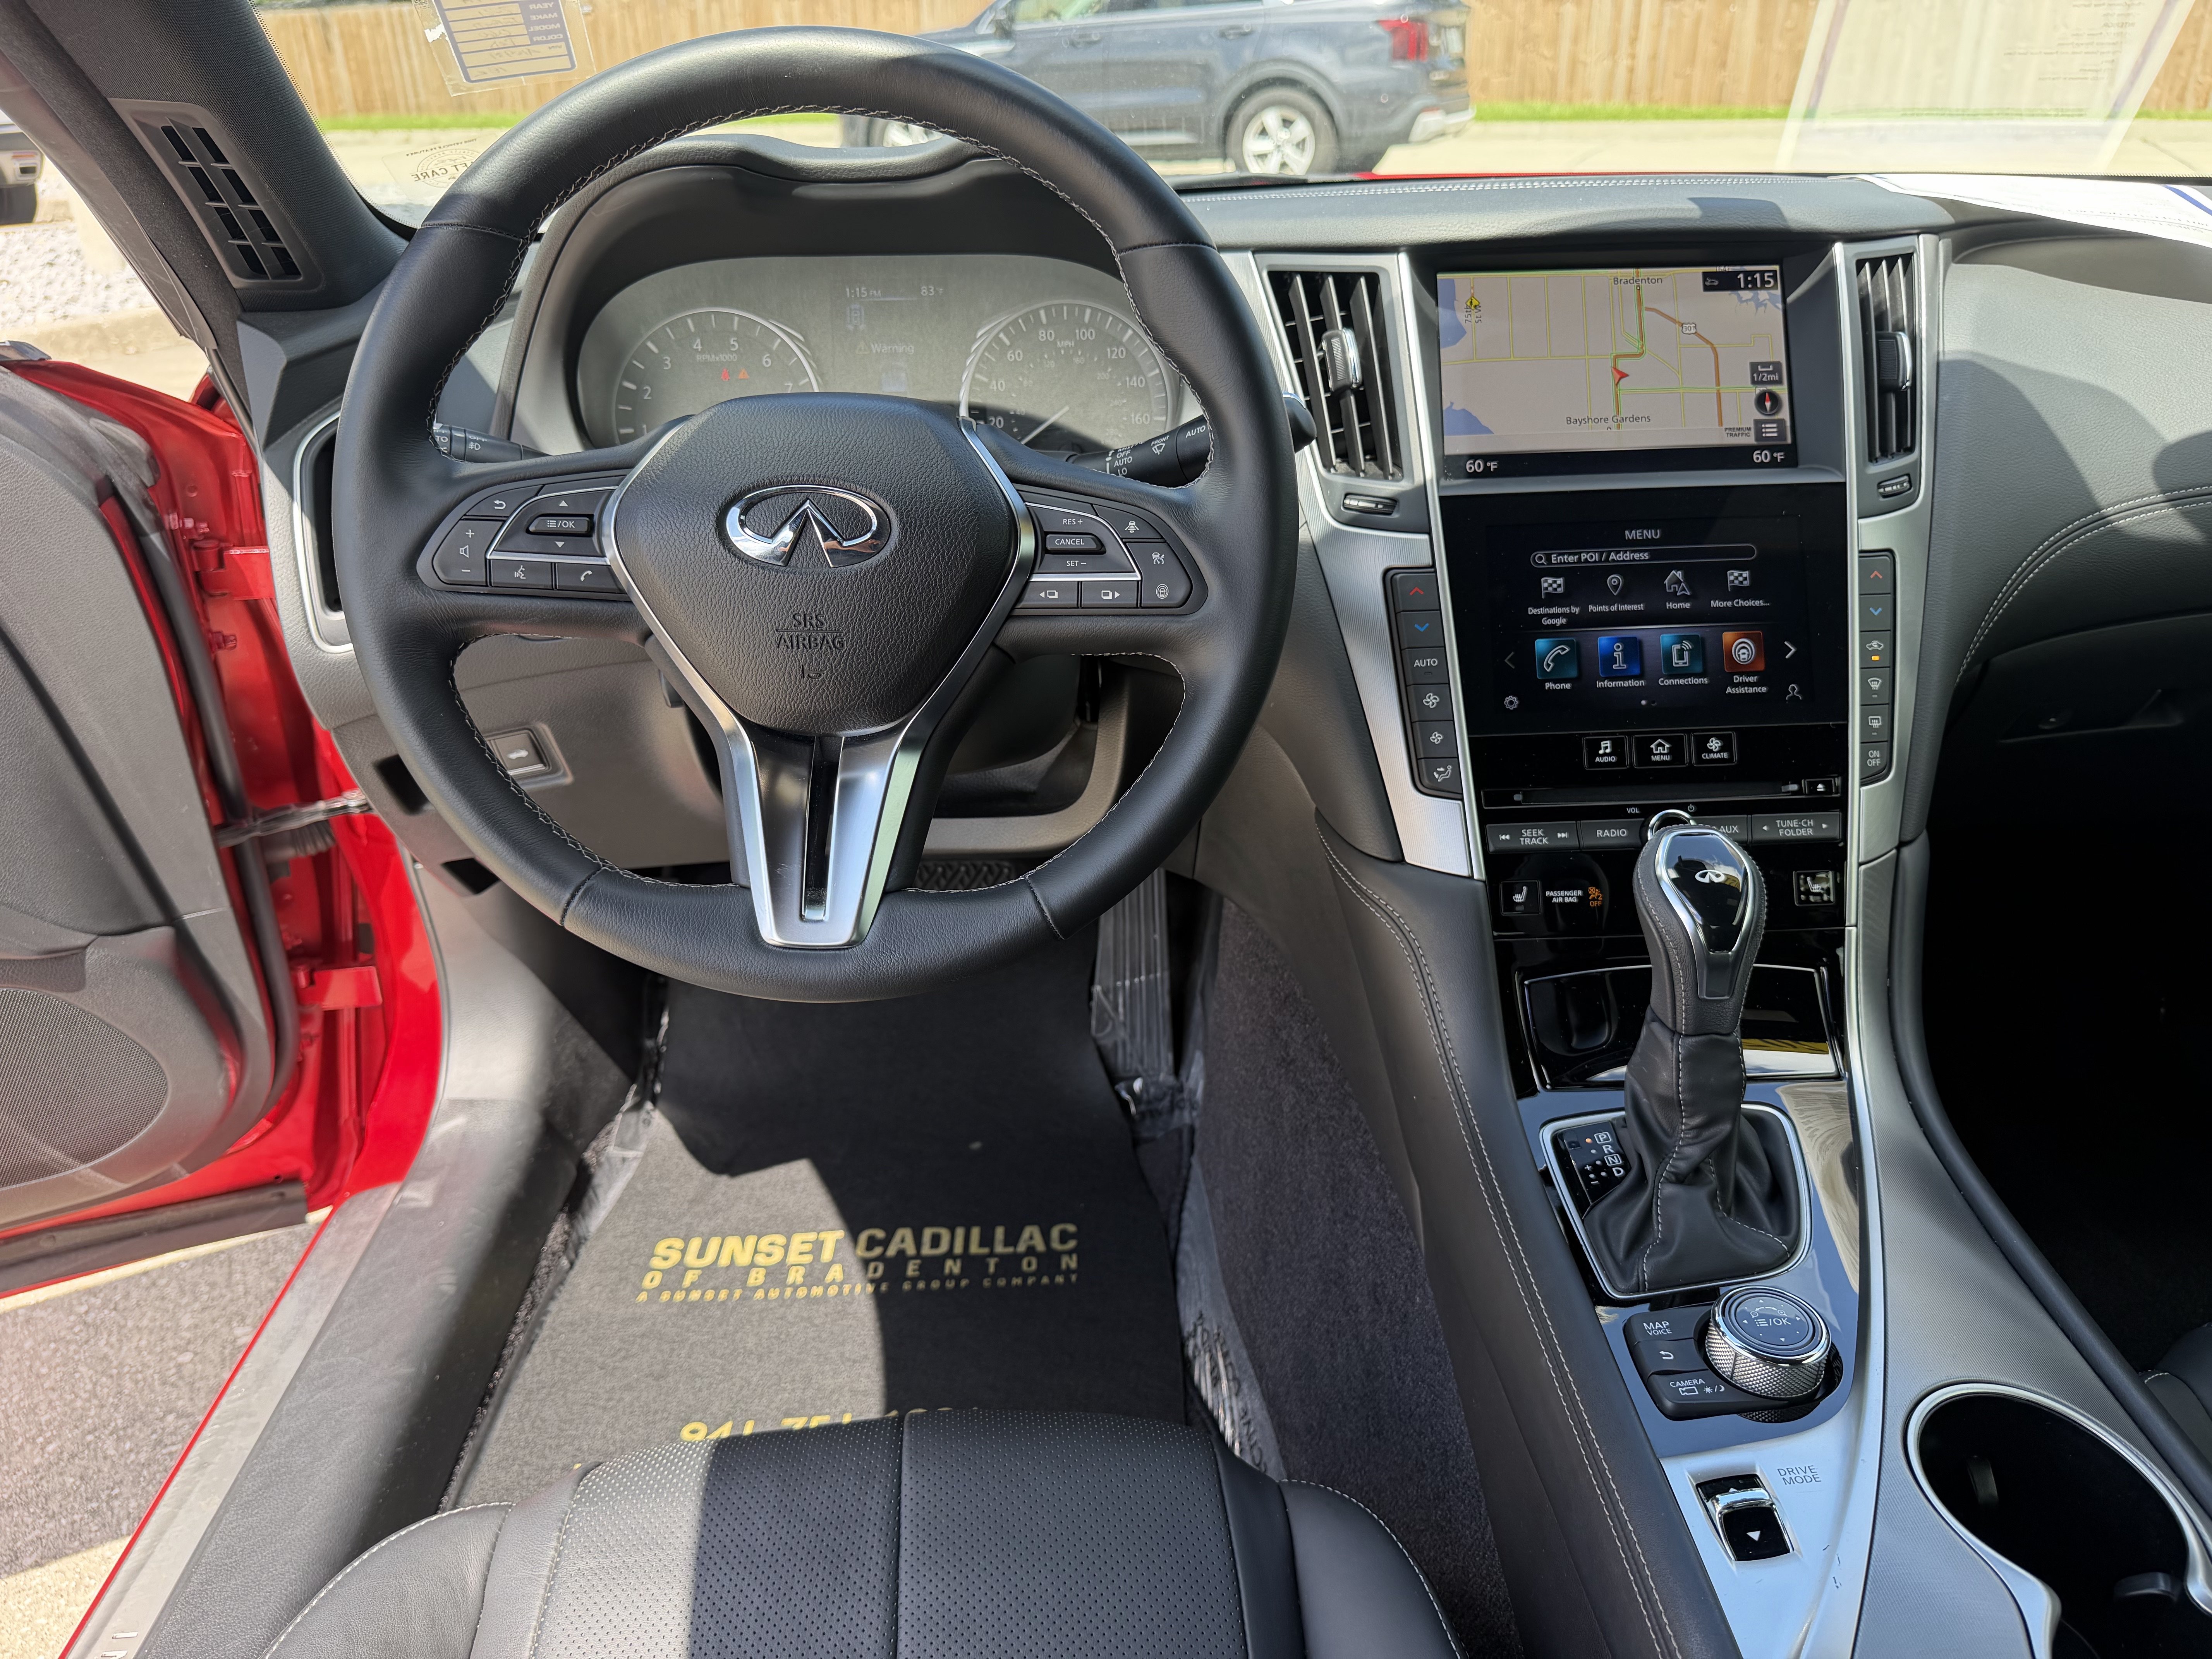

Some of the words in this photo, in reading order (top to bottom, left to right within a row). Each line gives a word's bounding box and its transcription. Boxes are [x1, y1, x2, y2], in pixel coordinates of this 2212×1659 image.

[1613, 276, 1662, 285] Bradenton
[1737, 272, 1774, 289] 1:15
[846, 287, 867, 297] 1:15
[1475, 315, 1482, 323] St
[1038, 330, 1055, 341] 80
[1076, 329, 1095, 340] 100
[694, 338, 702, 351] 4
[730, 338, 738, 351] 5
[871, 343, 914, 354] Warning
[1007, 350, 1023, 361] 60
[1107, 348, 1126, 359] 120
[663, 356, 671, 369] 3
[762, 354, 771, 367] 6
[990, 380, 1005, 391] 40
[1126, 376, 1145, 388] 140
[643, 386, 652, 400] 2
[988, 416, 1004, 428] 20
[1130, 414, 1150, 424] 160
[1566, 416, 1609, 426] Bayshore
[1611, 414, 1651, 424] Gardens
[1186, 425, 1206, 438] AUTO
[1151, 435, 1170, 446] FRONT
[1116, 450, 1131, 459] OFF
[1753, 450, 1771, 463] 60
[1114, 456, 1132, 467] AUTO
[1466, 459, 1484, 472] 60
[1118, 467, 1127, 476] LO
[1625, 529, 1661, 540] MENU
[1551, 554, 1578, 563] Enter
[1582, 553, 1599, 562] POI
[1609, 551, 1649, 561] Address
[1528, 606, 1570, 615] Destinations
[1571, 605, 1580, 615] by
[1589, 603, 1609, 612] Points
[1611, 603, 1618, 611] of
[1619, 603, 1644, 611] Interest
[793, 613, 826, 628] SRS
[1542, 617, 1567, 626] Google
[777, 634, 845, 649] AIRBAG
[1414, 659, 1438, 667] AUTO
[1597, 679, 1645, 688] Information
[1658, 677, 1709, 686] Connections
[1726, 686, 1768, 694] Assistance
[1521, 829, 1544, 837] SEEK
[1597, 829, 1627, 838] RADIO
[1520, 837, 1549, 845] TRACK
[1599, 1134, 1607, 1142] P
[1602, 1145, 1614, 1154] R
[1608, 1156, 1618, 1164] N
[1612, 1167, 1624, 1176] D
[649, 1230, 845, 1269] SUNSET
[855, 1223, 1078, 1259] CADILLAC
[642, 1269, 702, 1289] OF
[747, 1253, 1078, 1287] BRADENTON
[635, 1291, 648, 1303] A
[660, 1288, 743, 1302] SUNSET
[753, 1282, 889, 1301] AUTOMOTIVE
[902, 1278, 969, 1292] GROUP
[982, 1273, 1078, 1288] COMPANY
[1644, 1321, 1669, 1330] MAP
[1647, 1328, 1672, 1336] VOICE
[1670, 1378, 1705, 1388] CAMERA
[1777, 1465, 1817, 1476] DRIVE
[1782, 1474, 1822, 1485] MODE
